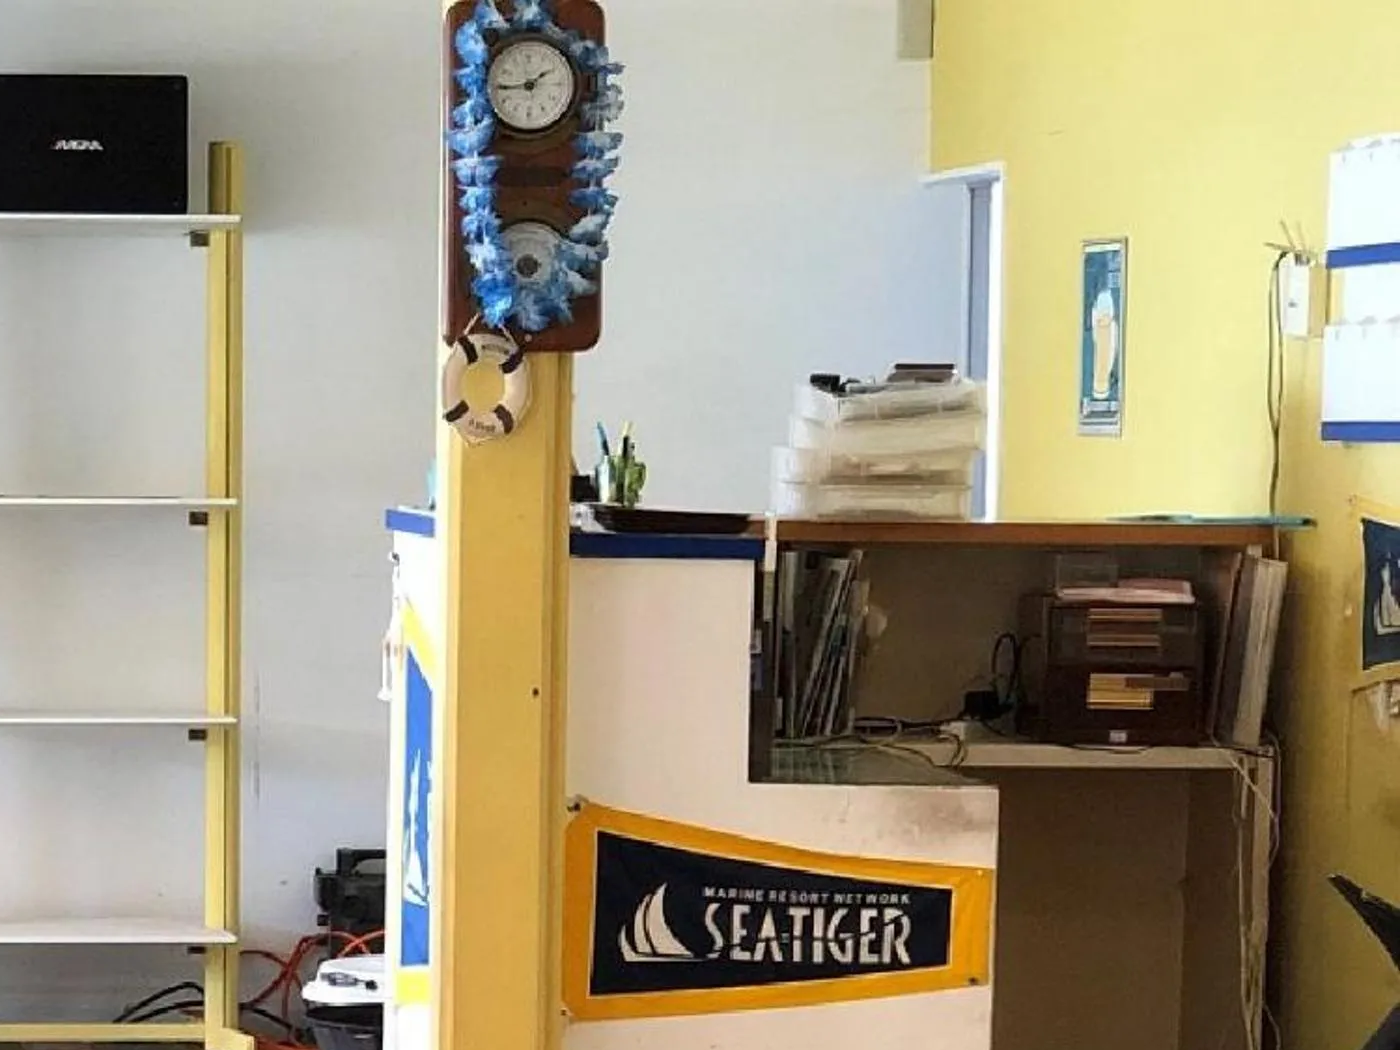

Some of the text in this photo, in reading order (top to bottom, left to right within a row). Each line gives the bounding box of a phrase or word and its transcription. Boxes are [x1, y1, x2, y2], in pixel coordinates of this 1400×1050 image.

[704, 886, 911, 905] MARINE RESORT NETWORK
